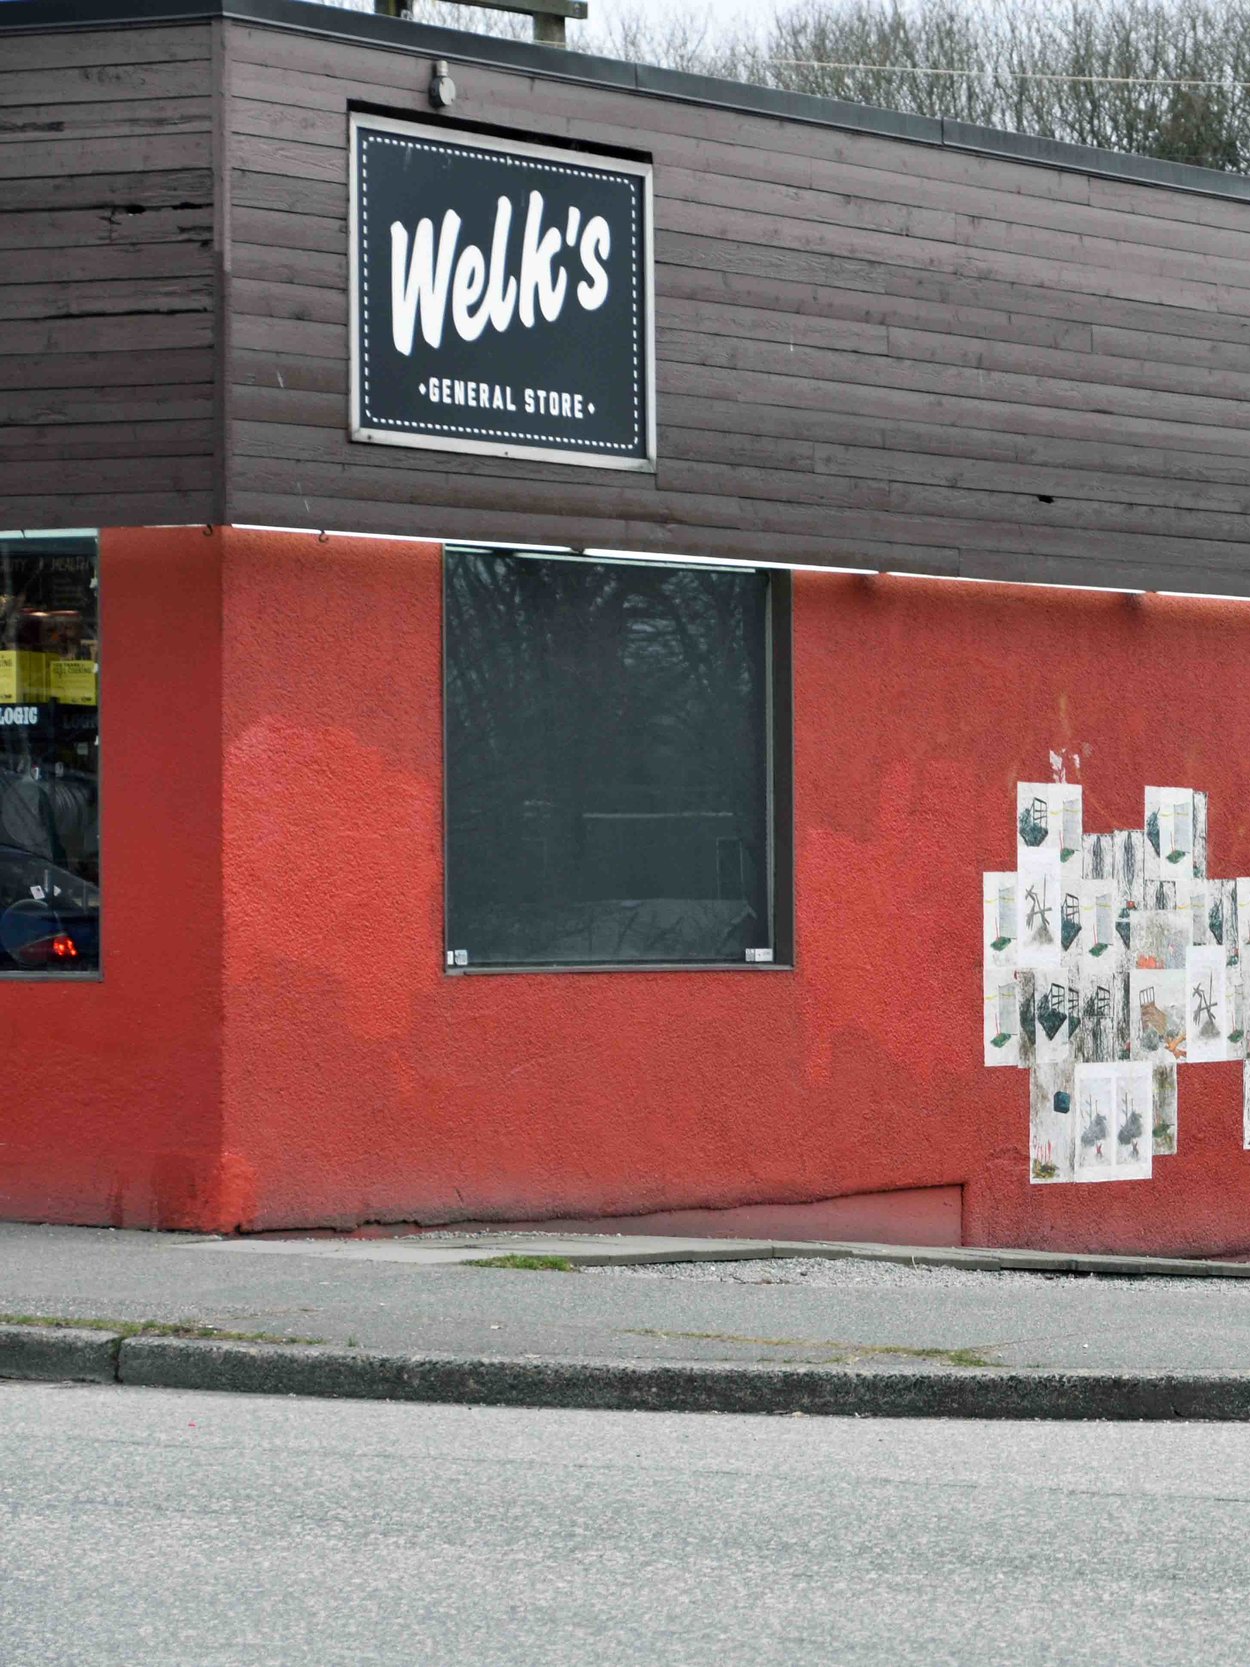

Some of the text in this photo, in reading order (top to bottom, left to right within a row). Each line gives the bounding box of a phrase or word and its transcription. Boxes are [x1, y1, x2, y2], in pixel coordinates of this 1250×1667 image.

[390, 190, 612, 356] Welk's
[428, 377, 584, 419] GENERAL STORE
